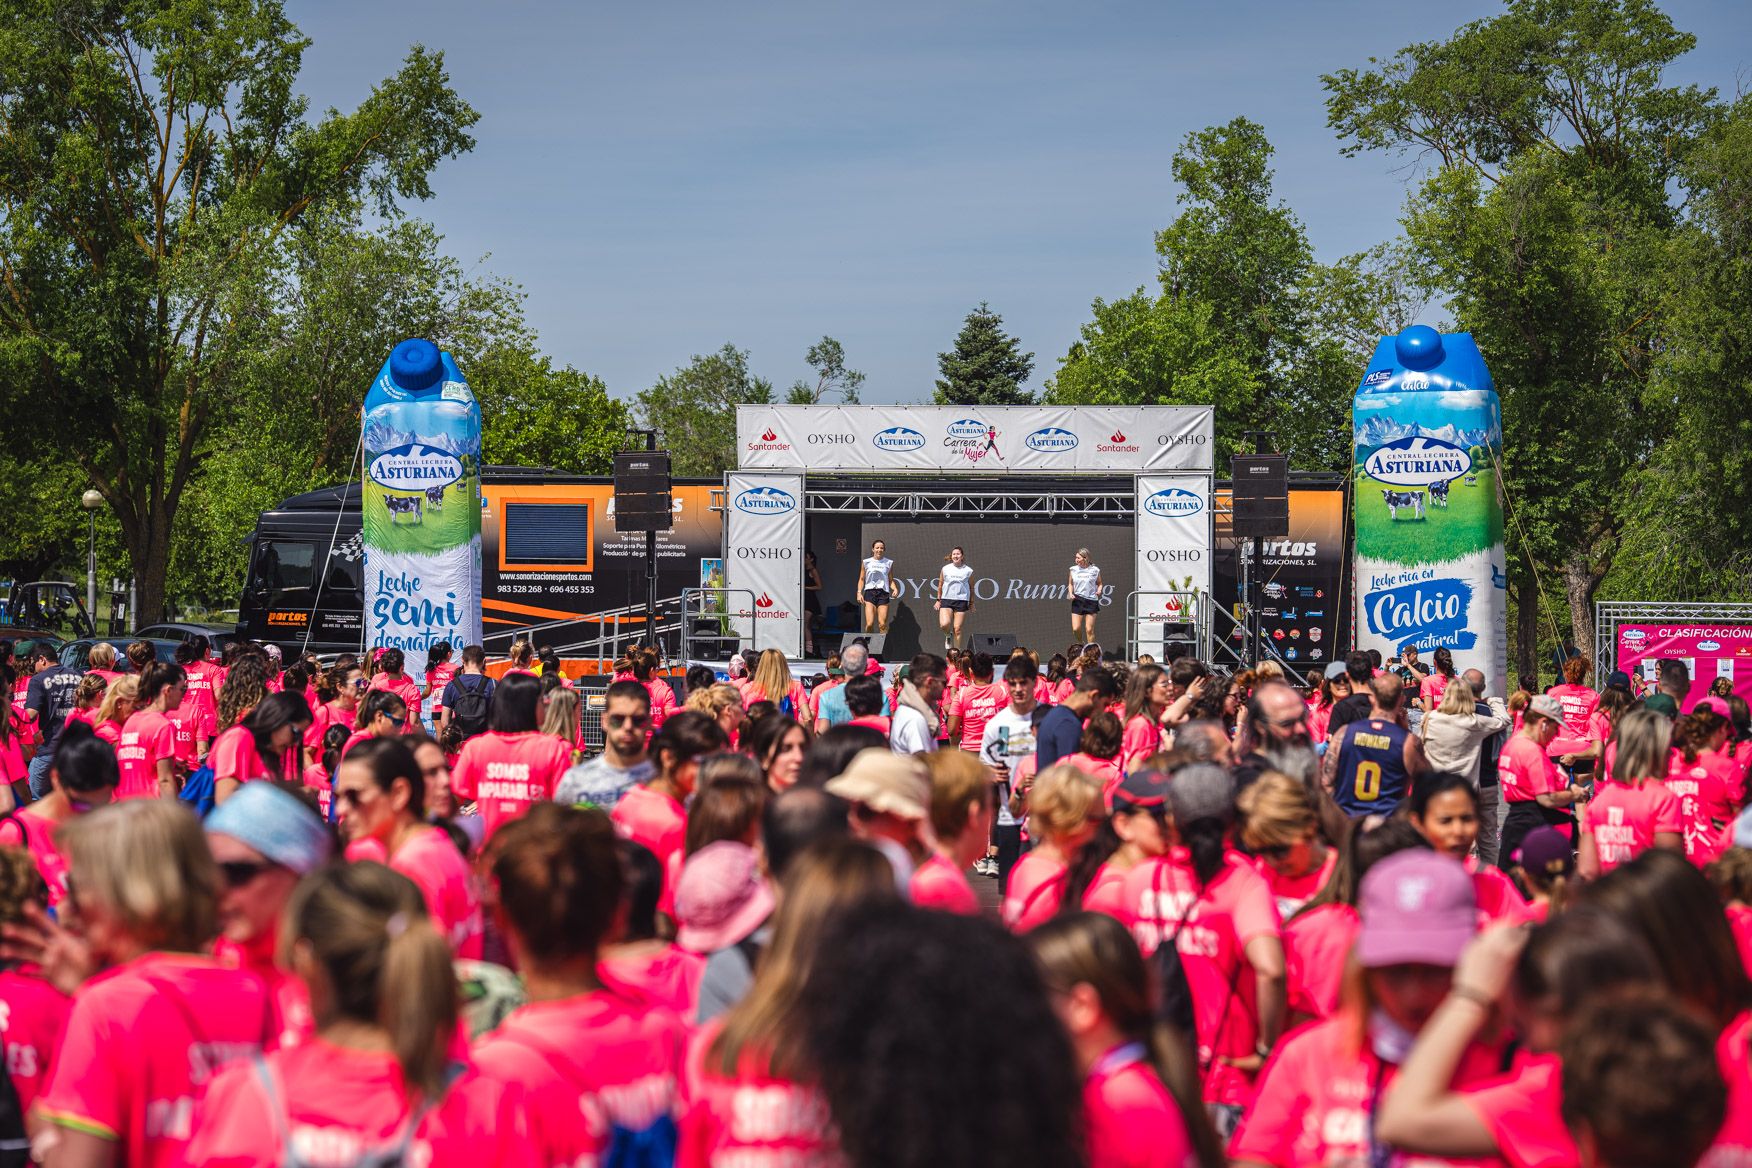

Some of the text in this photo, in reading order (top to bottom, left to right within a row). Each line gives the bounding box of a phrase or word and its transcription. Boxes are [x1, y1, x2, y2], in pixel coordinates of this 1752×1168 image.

[950, 426, 985, 434] ASTURIANA
[808, 433, 855, 444] OYSHO
[877, 436, 922, 446] ASTURIANA
[943, 437, 977, 447] Carrera
[1029, 437, 1075, 446] ASTURIANA
[1157, 434, 1206, 446] OYSHO
[748, 443, 790, 451] Santander
[1096, 444, 1139, 453] Santander
[963, 447, 988, 462] Mujer
[375, 461, 457, 479] ASTURIANA
[1370, 456, 1463, 475] ASTURIANA
[740, 497, 791, 508] ASTURIANA
[1149, 499, 1199, 510] ASTURIANA
[737, 547, 792, 559] OYSHO
[1147, 550, 1201, 562] OYSHO
[499, 572, 592, 582] www.sonorizacionesportos.com
[1370, 569, 1434, 591] Leche rica en
[375, 570, 422, 598] Leche
[497, 585, 511, 593] 983
[512, 585, 527, 593] 528
[528, 585, 542, 593] 268
[549, 585, 564, 593] 696
[565, 585, 579, 593] 455
[890, 577, 1115, 606] OYSO Runng
[374, 592, 463, 629] semi
[1373, 590, 1460, 633] Calcio
[1658, 626, 1752, 638] CLASIFICACIÓN
[1411, 630, 1459, 650] natural
[972, 697, 996, 708] SOMOS
[1354, 732, 1391, 750] HOWARD
[487, 762, 530, 781] SOMOS
[1354, 760, 1382, 801] 0
[1608, 806, 1624, 825] TU
